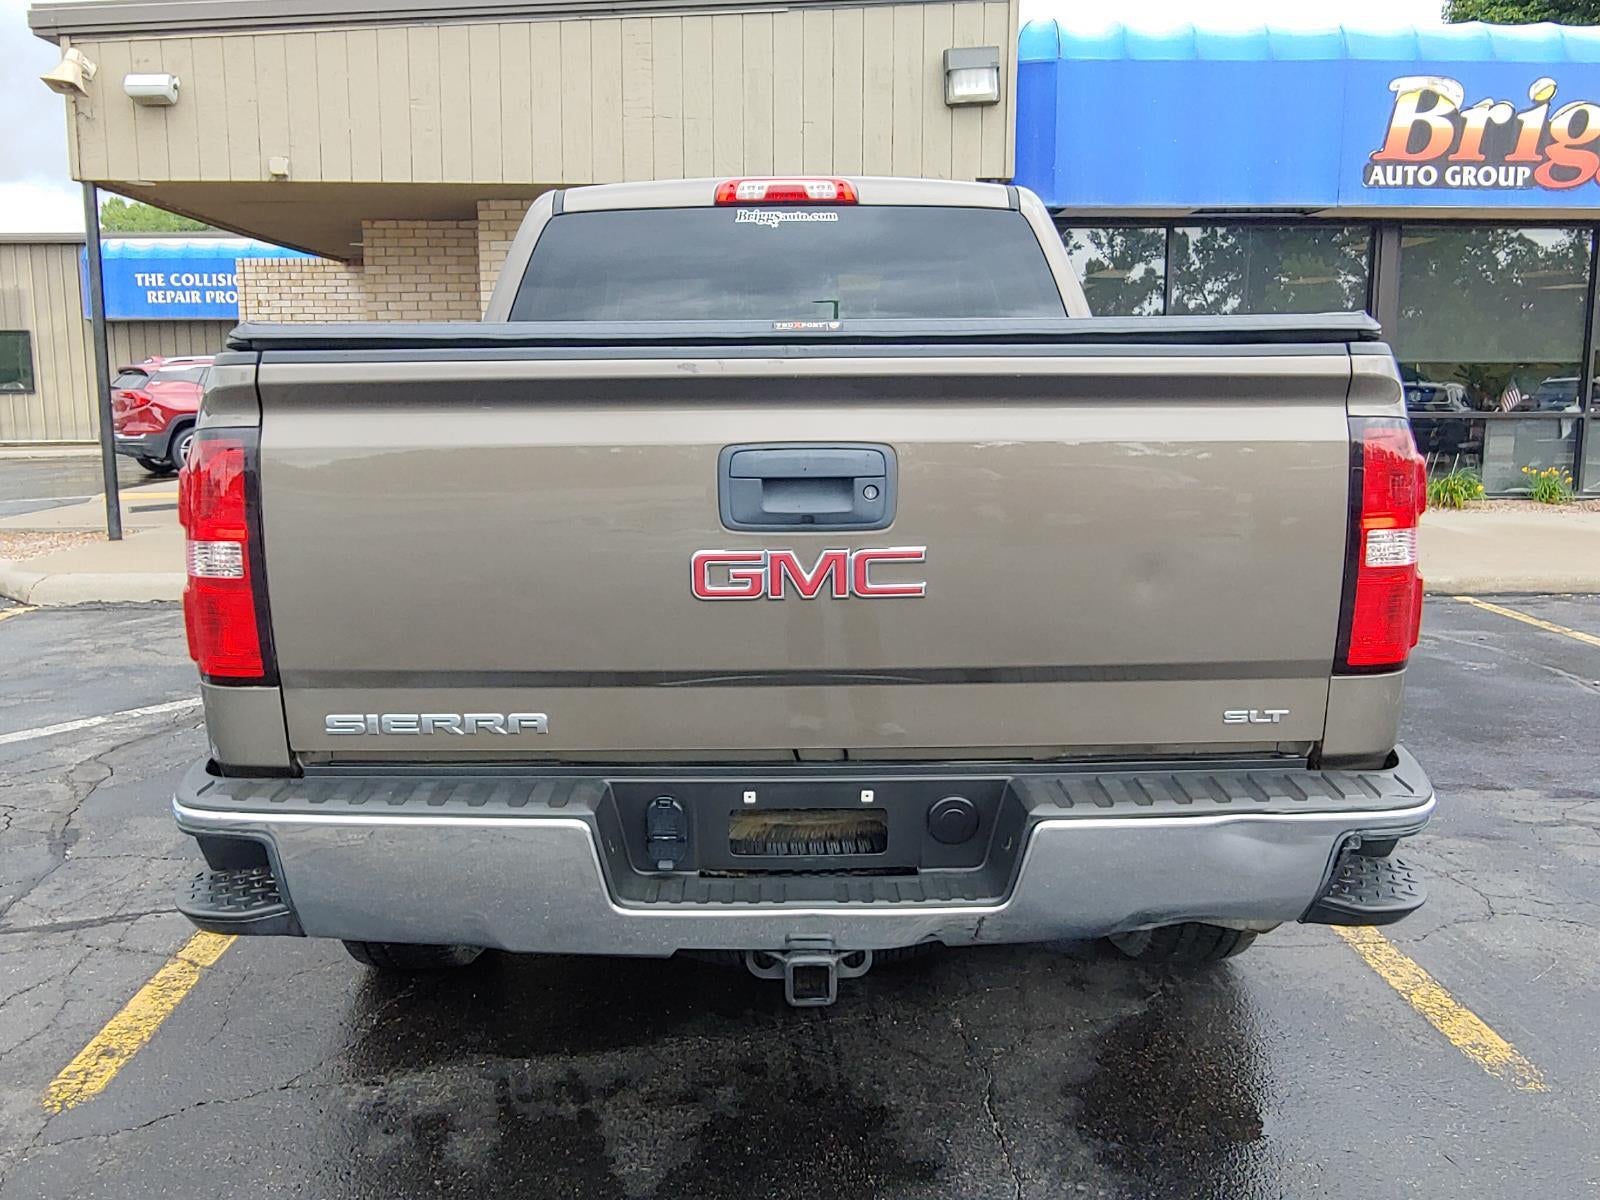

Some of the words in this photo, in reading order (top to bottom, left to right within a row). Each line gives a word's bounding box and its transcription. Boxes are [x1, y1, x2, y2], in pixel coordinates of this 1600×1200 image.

[1370, 75, 1600, 188] Brig
[1368, 165, 1438, 186] AUTO
[1445, 165, 1531, 187] GROUP
[134, 273, 164, 287] THE
[147, 290, 201, 304] REPAIR
[205, 290, 238, 304] PRO
[691, 546, 927, 600] GMC
[325, 713, 549, 735] SIERRA
[1223, 709, 1290, 724] SLT
